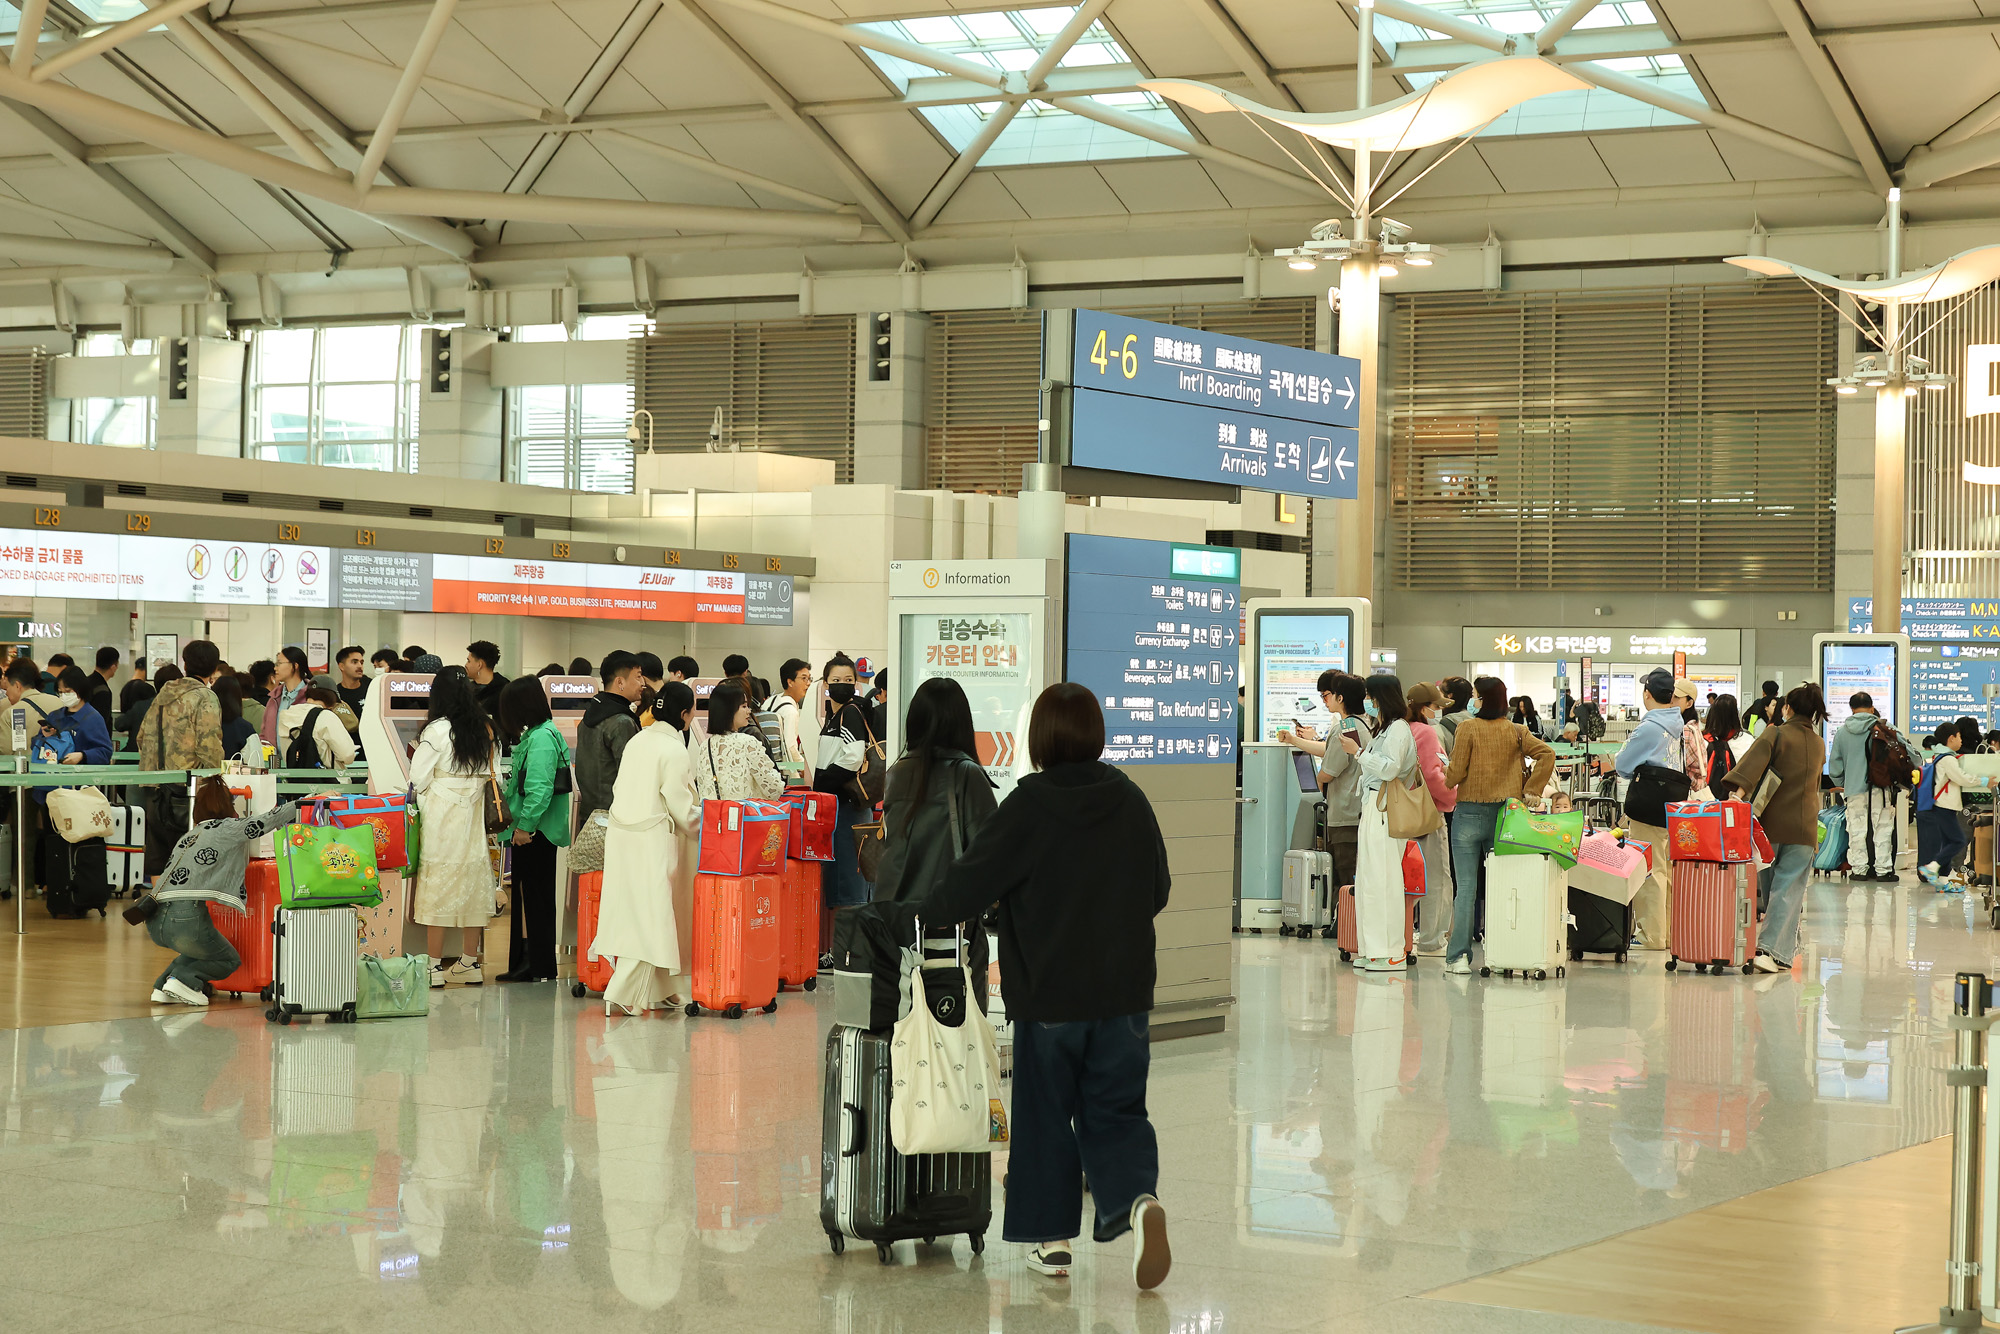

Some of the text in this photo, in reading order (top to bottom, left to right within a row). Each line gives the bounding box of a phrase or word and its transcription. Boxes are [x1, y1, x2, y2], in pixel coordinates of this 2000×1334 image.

[1090, 329, 1138, 379] 4-6
[1207, 375, 1261, 408] Boarding
[1269, 369, 1333, 405] 국제선탑승
[1274, 442, 1301, 471] 도착
[1220, 452, 1267, 477] Arrivals
[35, 507, 61, 526] L28
[127, 513, 151, 532] L29
[279, 524, 300, 541] L30
[357, 530, 376, 546] L31
[486, 538, 505, 554] L32
[552, 543, 570, 558] L33
[0, 545, 84, 565] 수하물 금지 물품
[664, 550, 681, 565] L34
[724, 554, 739, 568] L35
[514, 564, 545, 579] 제주항공
[766, 557, 781, 571] L36
[23, 570, 65, 582] BAGGAGE
[68, 573, 117, 584] PROHIBITED
[119, 574, 145, 585] ITEMS
[707, 576, 733, 589] 제주항공
[945, 572, 1011, 584] Information
[477, 592, 510, 603] PRIORITY
[569, 597, 599, 607] BUSINESS
[614, 599, 642, 609] PREMIUM
[642, 601, 657, 610] PLUS
[1164, 599, 1184, 611] Toilets
[1187, 590, 1208, 607] 화장실
[696, 603, 742, 614] DUTY MANAGER
[1970, 602, 1998, 618] M,N
[938, 618, 1007, 641] 탑승수속
[1911, 630, 1938, 638] Check-in
[1972, 624, 2000, 638] K-A
[1135, 635, 1190, 650] Currency Exchange
[1526, 636, 1553, 654] KB
[1555, 636, 1611, 654] 국민은행
[1629, 635, 1667, 647] Currency
[926, 644, 1017, 666] 카운터 안내
[953, 670, 979, 678] COUNTER
[1124, 672, 1173, 686] Beverages, Food
[1193, 664, 1207, 680] 식사
[390, 681, 432, 692] Self Check-
[550, 682, 594, 693] Self Check-in
[696, 684, 709, 695] Self
[1157, 701, 1173, 717] Tax
[1174, 701, 1206, 717] Refund
[1105, 748, 1129, 761] Baggage
[1129, 747, 1154, 759] Check-in
[1157, 739, 1165, 754] 큰
[1166, 739, 1174, 754] 짐
[1176, 739, 1196, 754] 부치는
